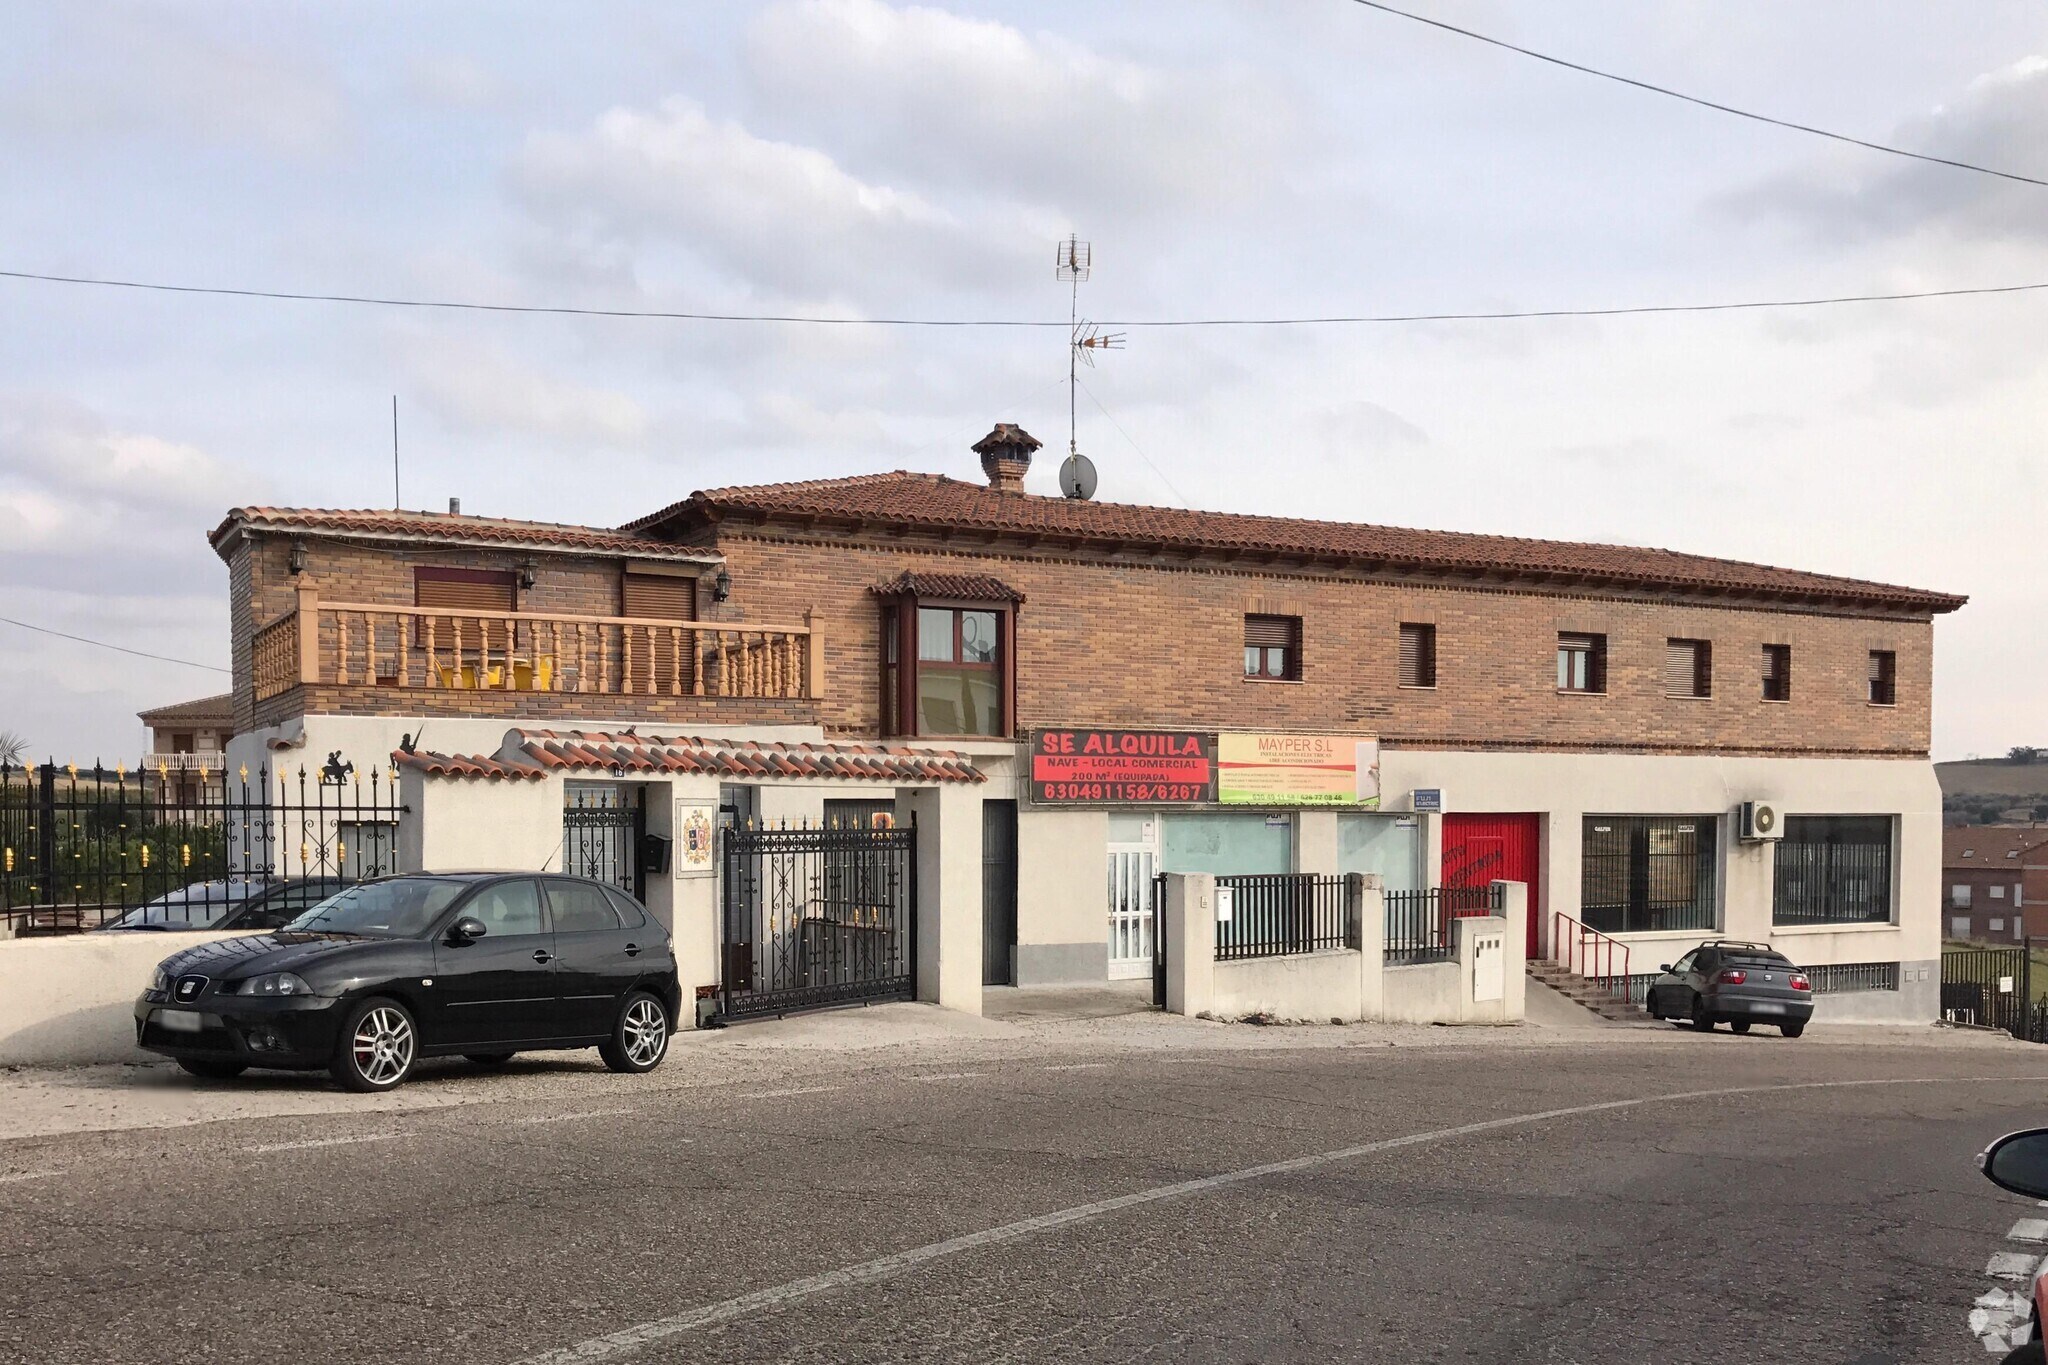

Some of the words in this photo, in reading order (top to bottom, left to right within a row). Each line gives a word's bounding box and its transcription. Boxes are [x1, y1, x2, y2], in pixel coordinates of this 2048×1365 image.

[1042, 732, 1075, 754] SE
[1083, 733, 1201, 756] ALQUILA
[1259, 738, 1311, 752] MAYPER
[1314, 739, 1333, 752] S.L
[1047, 758, 1079, 767] NAVE
[1091, 758, 1128, 768] LOCAL
[1131, 758, 1198, 769] COMERCIAL
[1071, 772, 1092, 780] 200
[1114, 772, 1169, 782] (EQUIPADA)
[1044, 783, 1201, 801] 630491158/6267
